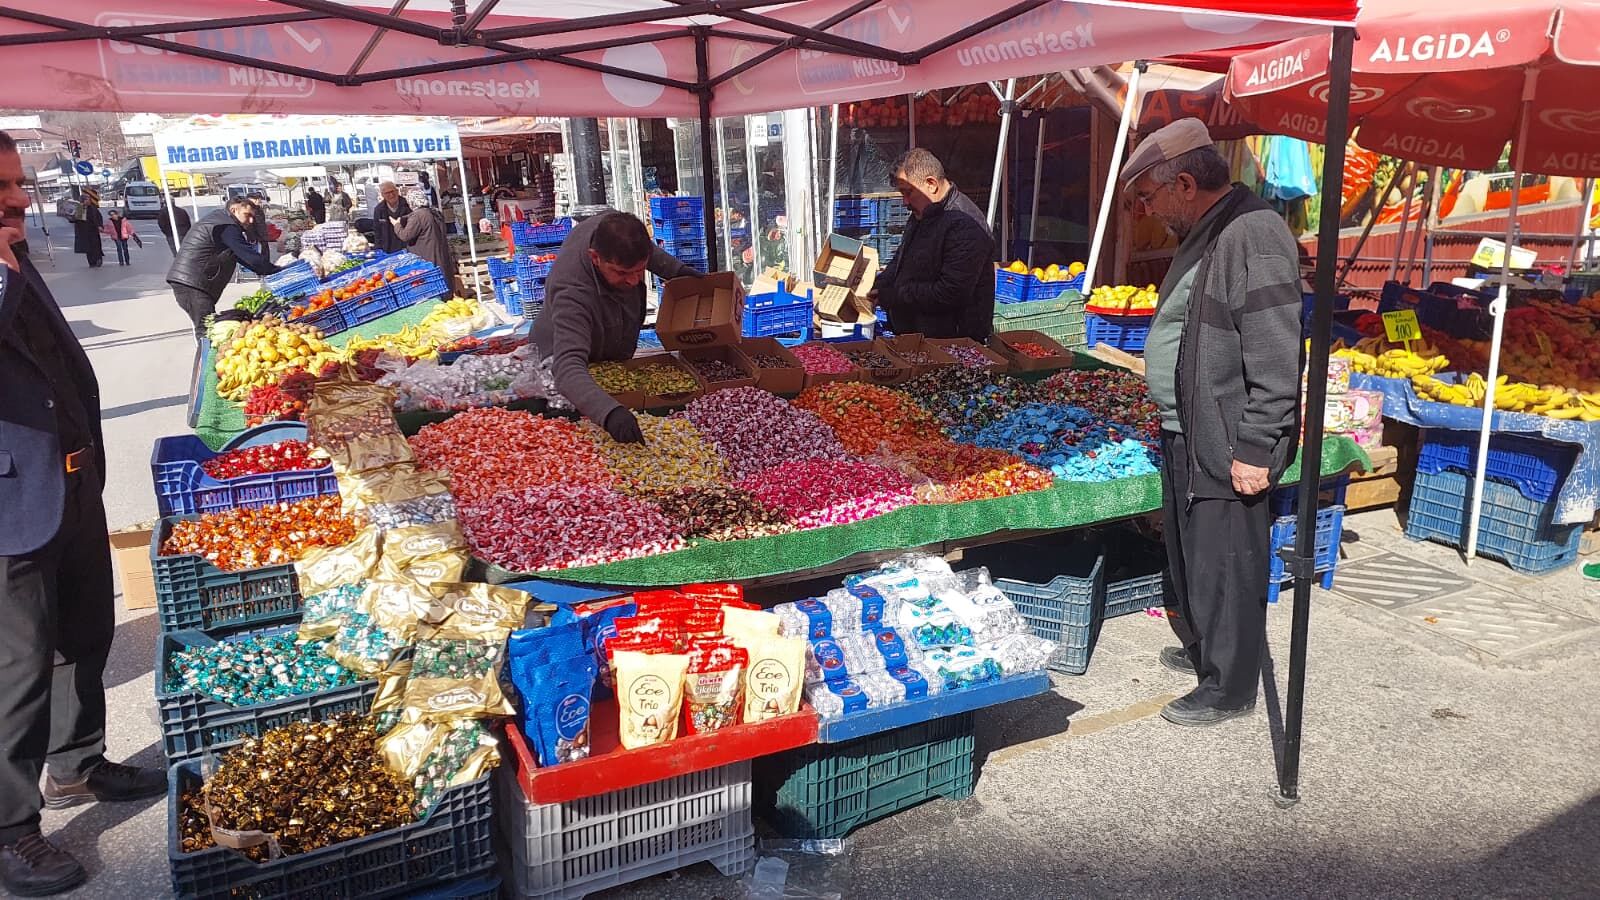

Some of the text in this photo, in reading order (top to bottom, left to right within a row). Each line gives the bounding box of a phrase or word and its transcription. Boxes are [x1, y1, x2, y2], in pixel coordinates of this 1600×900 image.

[166, 132, 451, 164] Manav İBRAHİM AĞA'nın yeri
[756, 666, 784, 680] Ece
[634, 682, 664, 696] Ece
[760, 682, 779, 694] Trio
[640, 698, 659, 710] Trio
[560, 705, 586, 723] Ece
